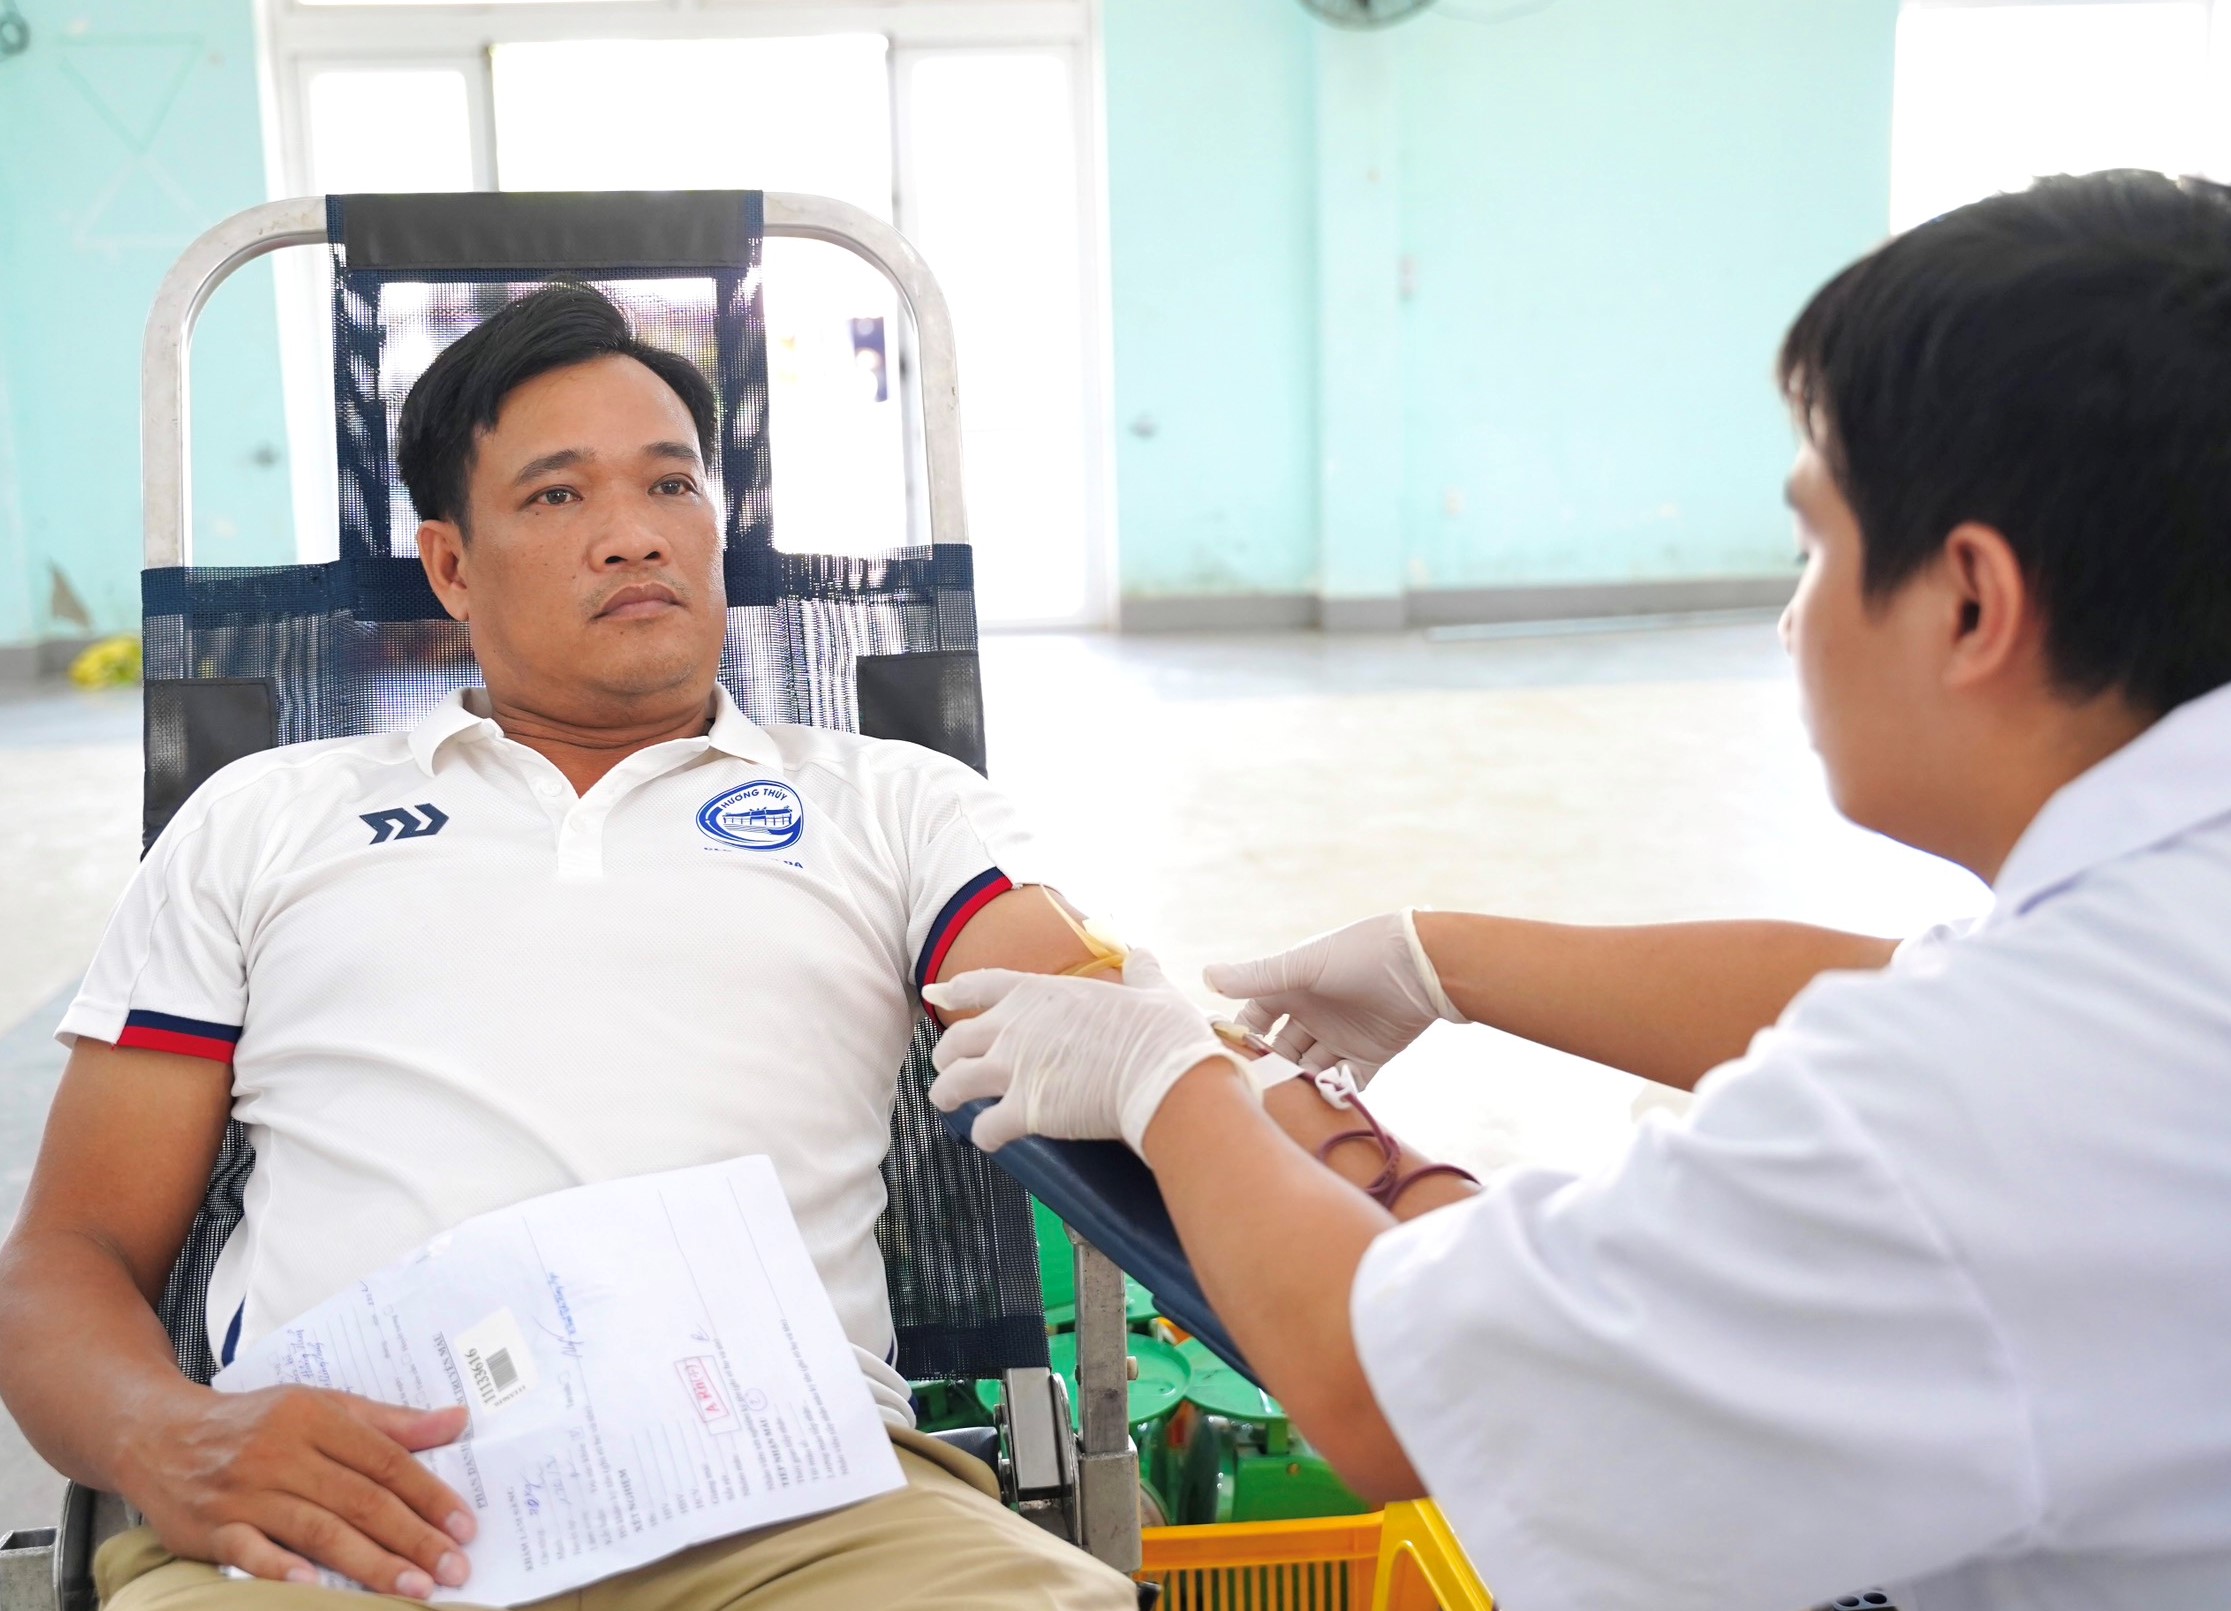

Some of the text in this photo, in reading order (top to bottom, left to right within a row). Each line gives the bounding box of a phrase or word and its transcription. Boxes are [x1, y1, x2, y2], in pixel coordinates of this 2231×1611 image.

[720, 788, 788, 809] HƯƠNG THỦY
[466, 1348, 496, 1404] 11133616
[705, 1403, 719, 1412] A
